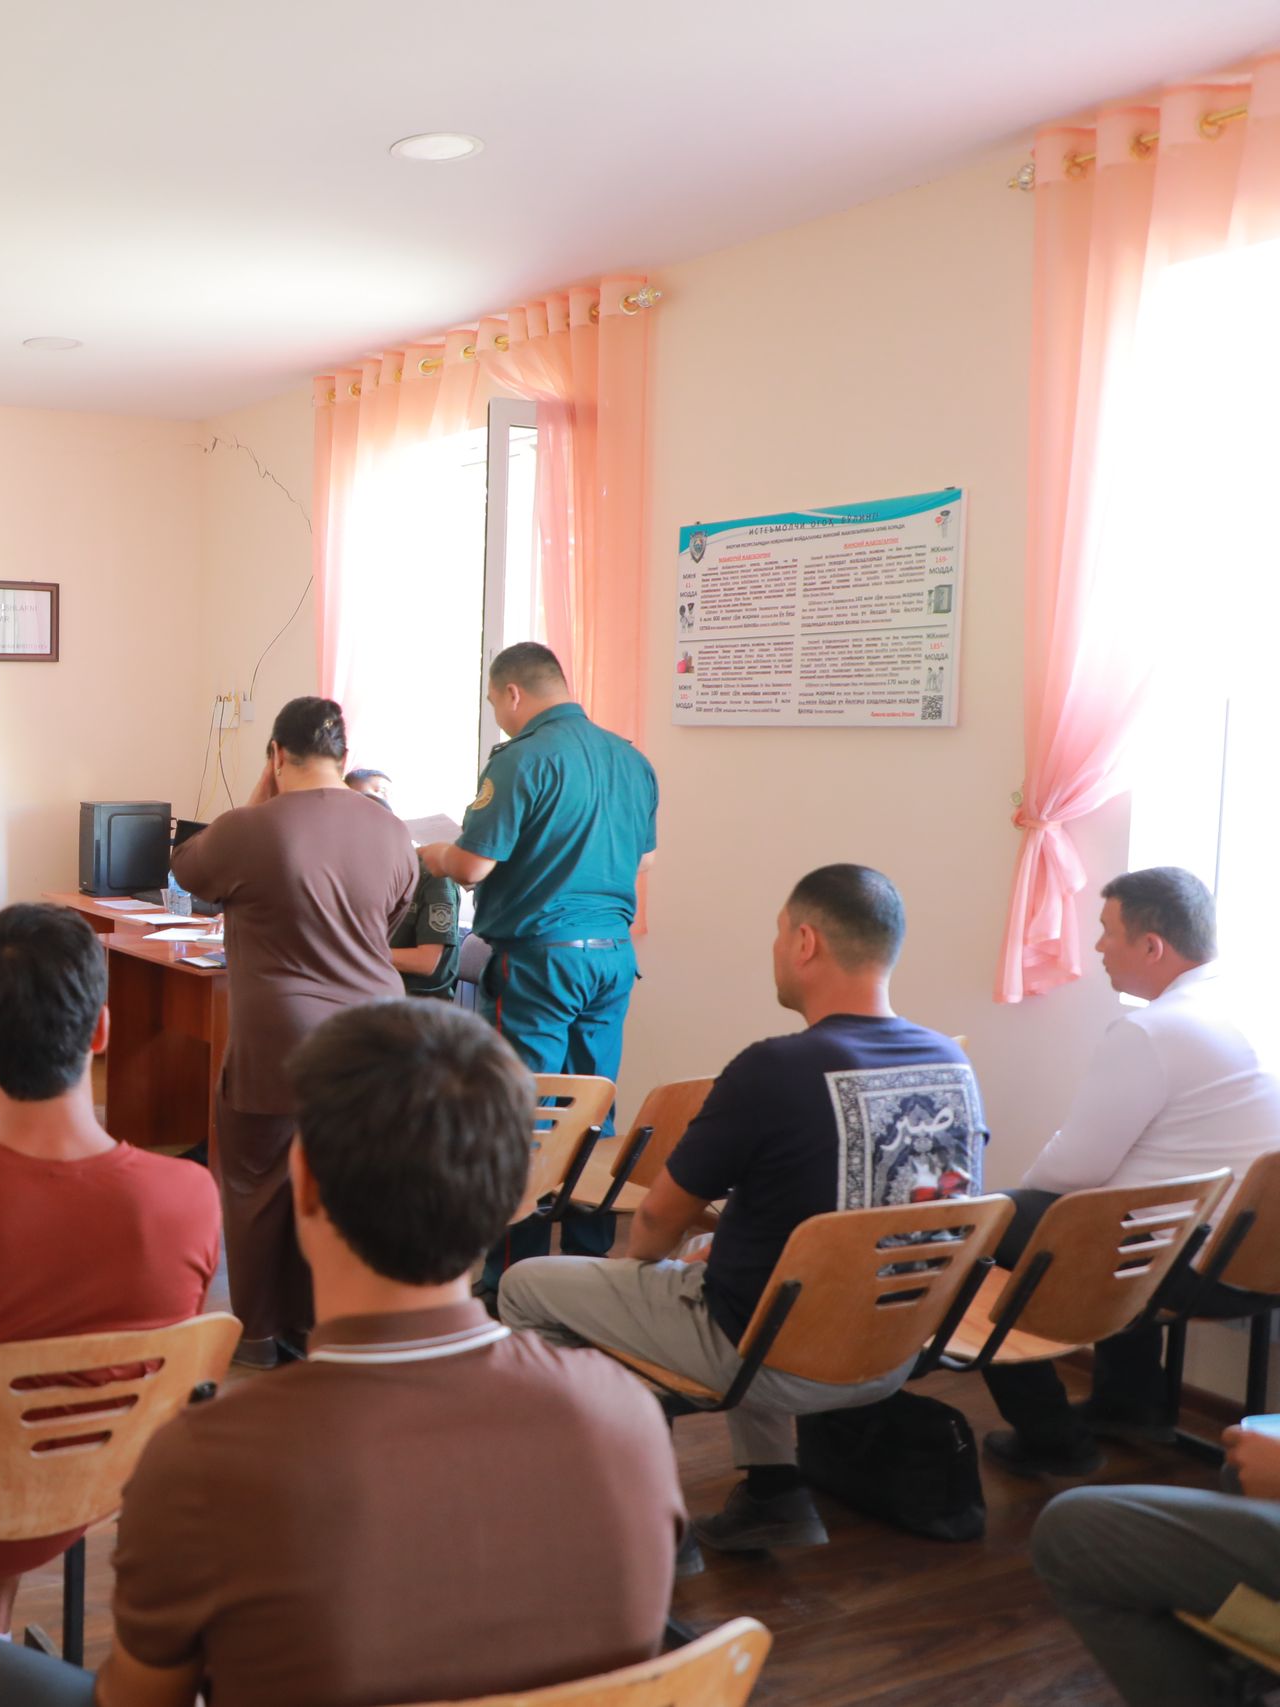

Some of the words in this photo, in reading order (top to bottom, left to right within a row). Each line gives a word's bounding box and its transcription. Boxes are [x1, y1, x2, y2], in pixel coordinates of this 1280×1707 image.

[928, 566, 954, 574] МОДДА
[924, 652, 949, 661] МОДДА
[881, 1105, 956, 1151] صبر
